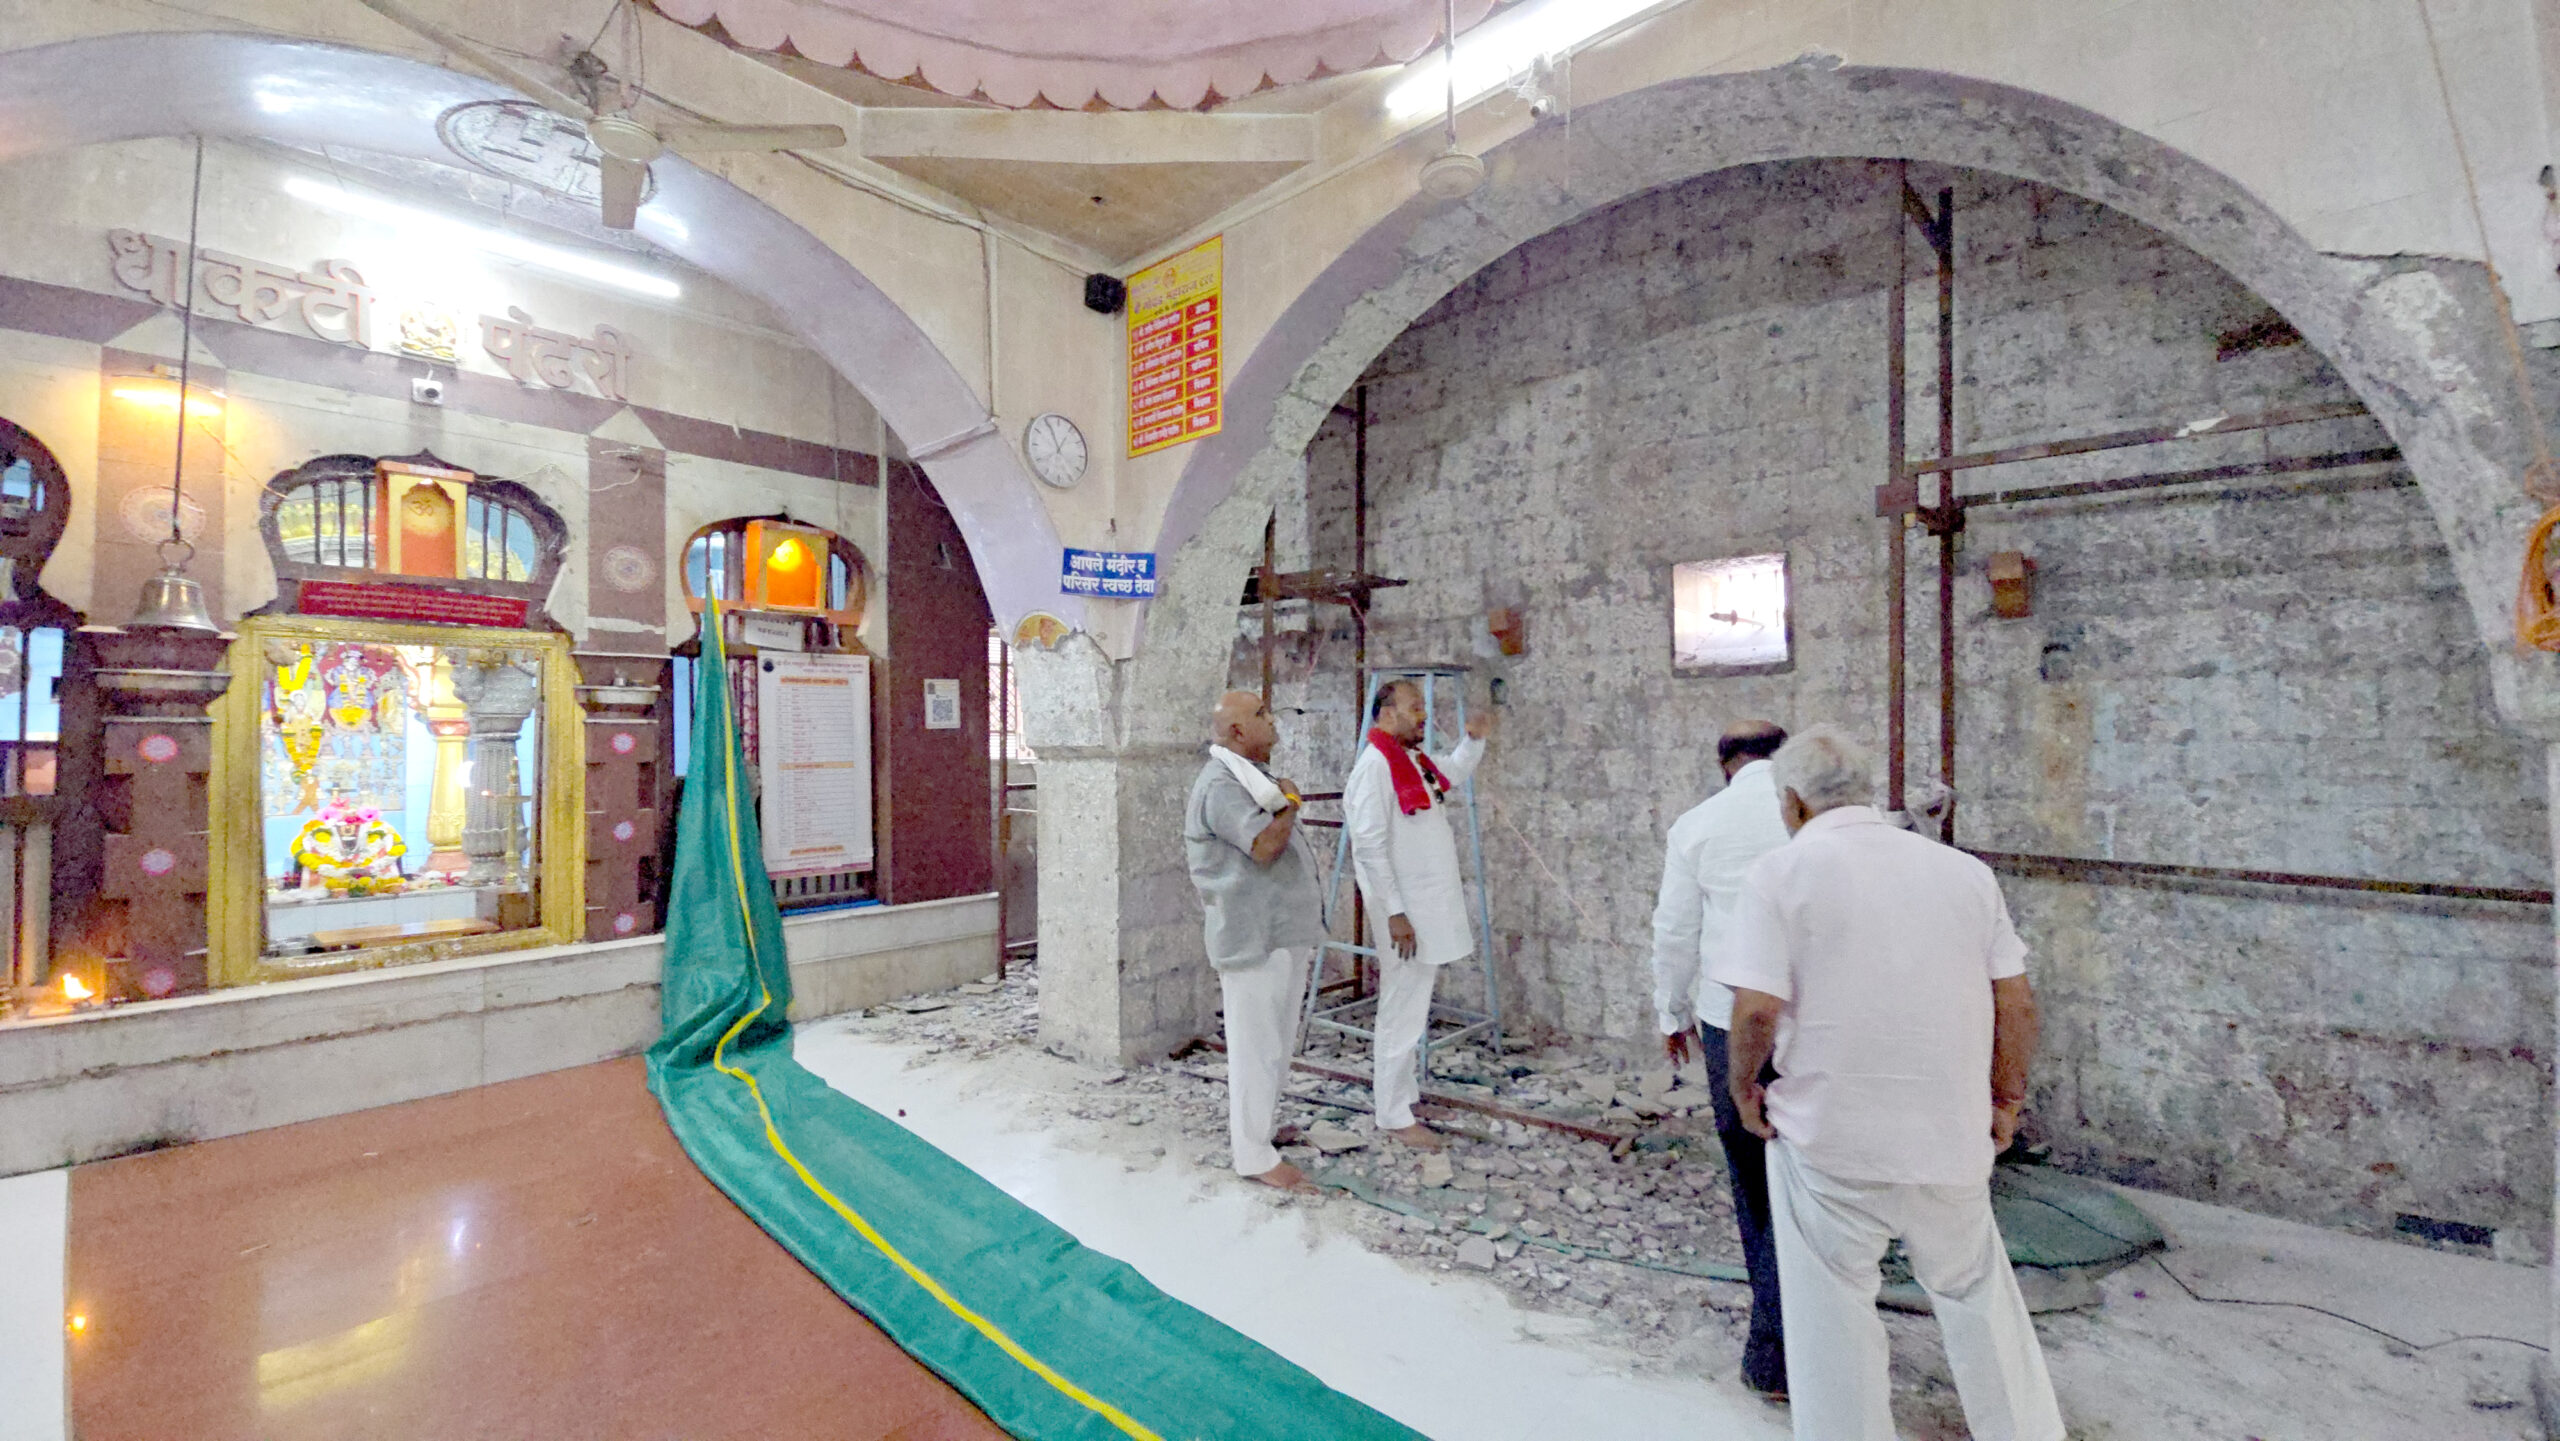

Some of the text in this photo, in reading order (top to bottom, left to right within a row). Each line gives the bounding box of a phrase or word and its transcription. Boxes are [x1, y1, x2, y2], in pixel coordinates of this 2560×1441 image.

[108, 228, 374, 349] धाकटी
[1070, 552, 1147, 576] आपले मंदीर व
[1063, 570, 1155, 593] परिसर स्वच्छ ठेवा
